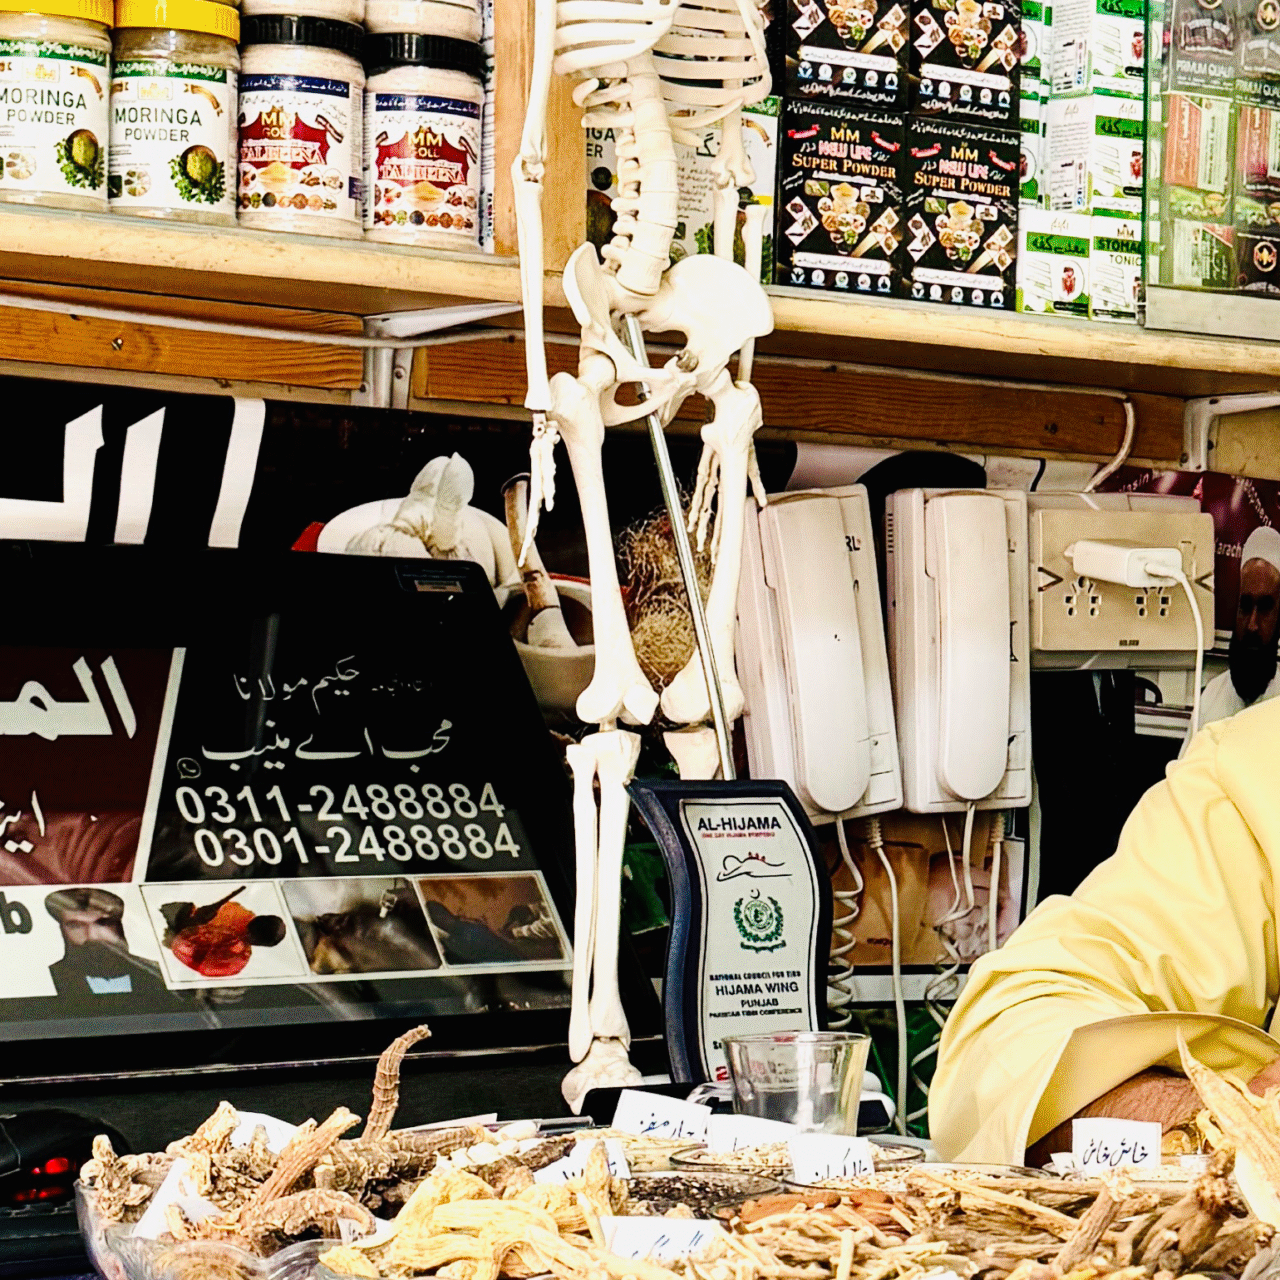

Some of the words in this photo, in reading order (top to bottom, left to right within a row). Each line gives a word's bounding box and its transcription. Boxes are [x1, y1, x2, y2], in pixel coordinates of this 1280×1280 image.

[7, 108, 76, 126] POWDER
[115, 106, 203, 127] MORINGA
[124, 128, 190, 143] POWDER
[831, 127, 860, 142] MM
[951, 146, 979, 162] MM
[792, 153, 837, 171] SUPER
[843, 158, 896, 179] POWDER
[914, 171, 956, 190] SUPER
[961, 179, 1011, 197] POWDER
[175, 782, 506, 826] 0311-2488884
[698, 816, 781, 831] AL-HIJAMA
[194, 823, 521, 868] 0301-2488884
[715, 983, 763, 996] HIJAMA
[765, 981, 799, 994] WING
[741, 998, 779, 1008] PUNJAB
